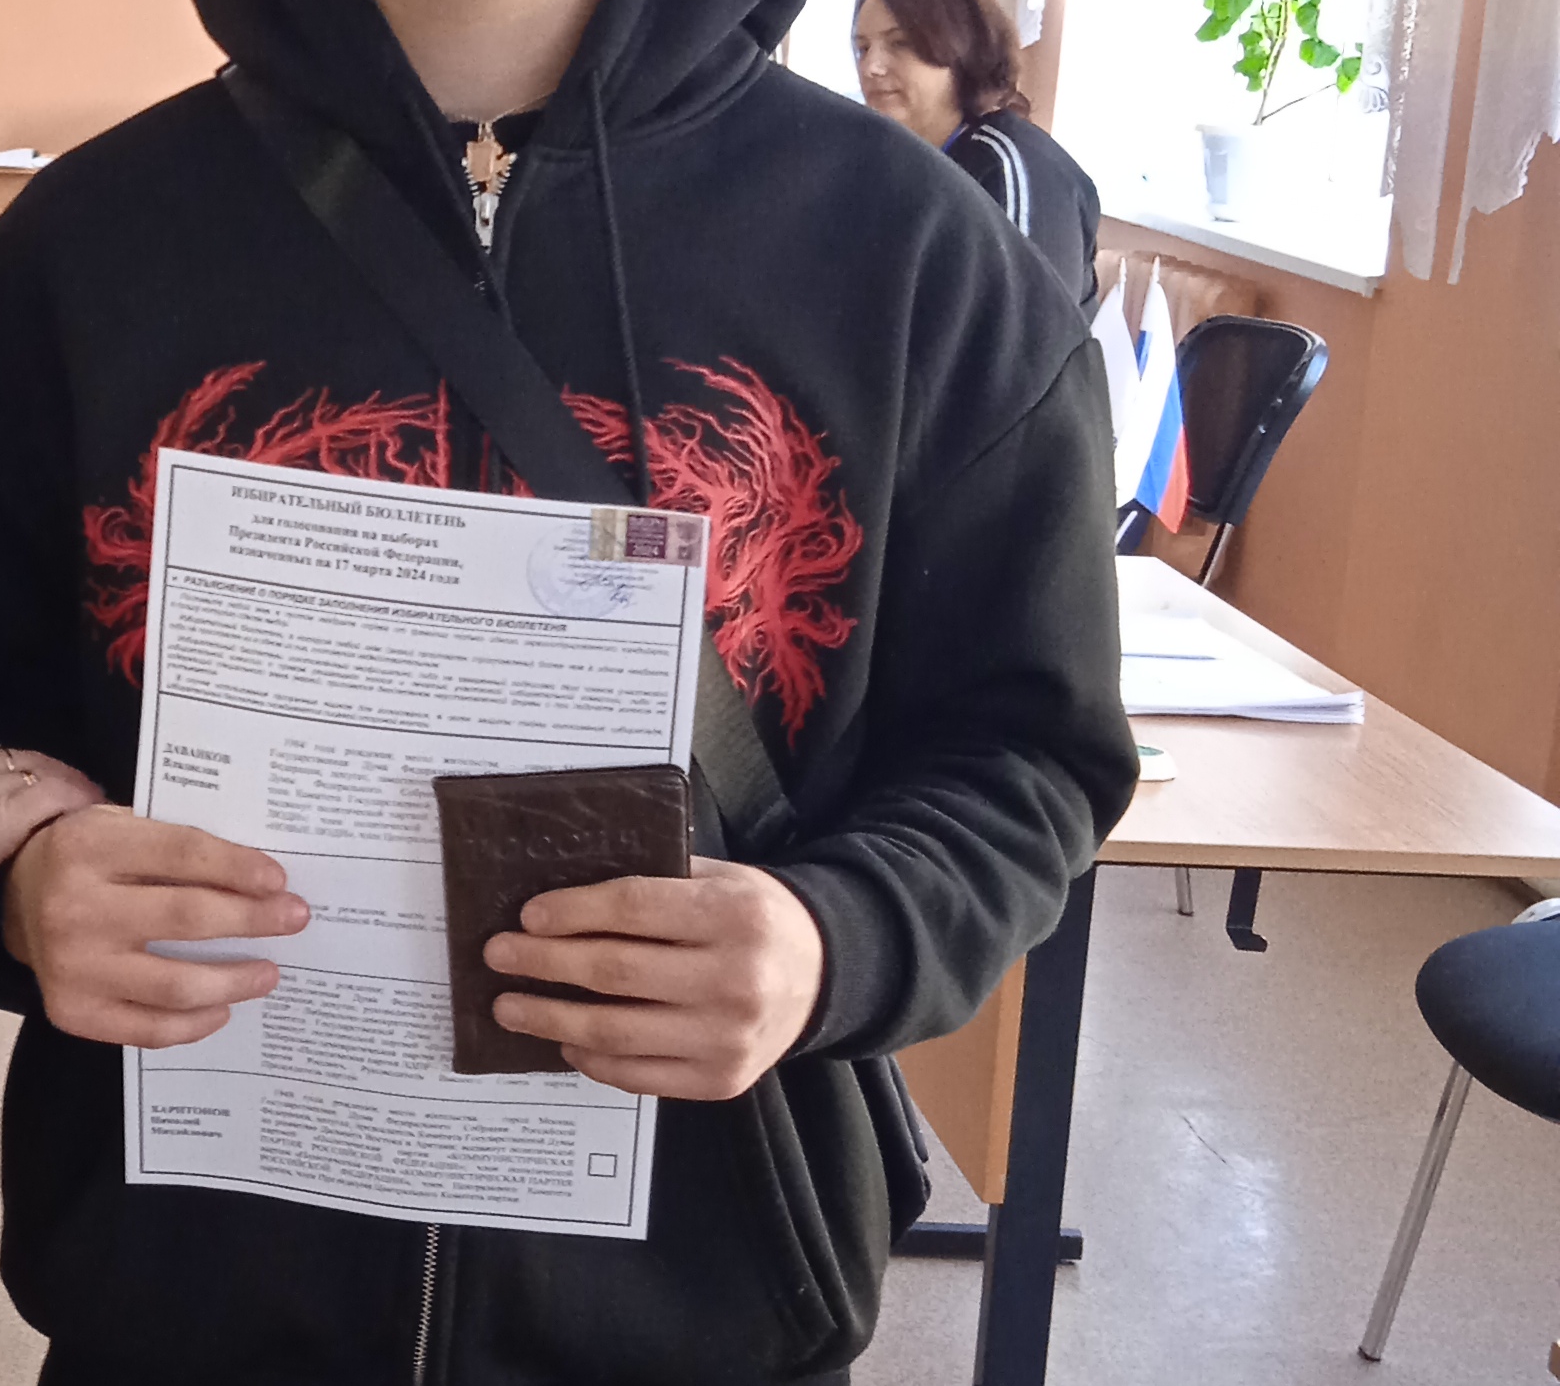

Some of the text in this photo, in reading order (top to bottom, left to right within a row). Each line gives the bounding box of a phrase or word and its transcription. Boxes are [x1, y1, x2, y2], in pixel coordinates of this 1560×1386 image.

[231, 485, 466, 528] ИЗБИРАТЕЛЬНЫЙ БЮЛЛЕТЕНЬ
[229, 524, 301, 547] Президента
[304, 536, 380, 558] Российской
[277, 518, 358, 538] голосования
[381, 533, 438, 549] выборах
[335, 559, 350, 570] 17
[353, 564, 392, 578] марта
[396, 566, 426, 580] 2024
